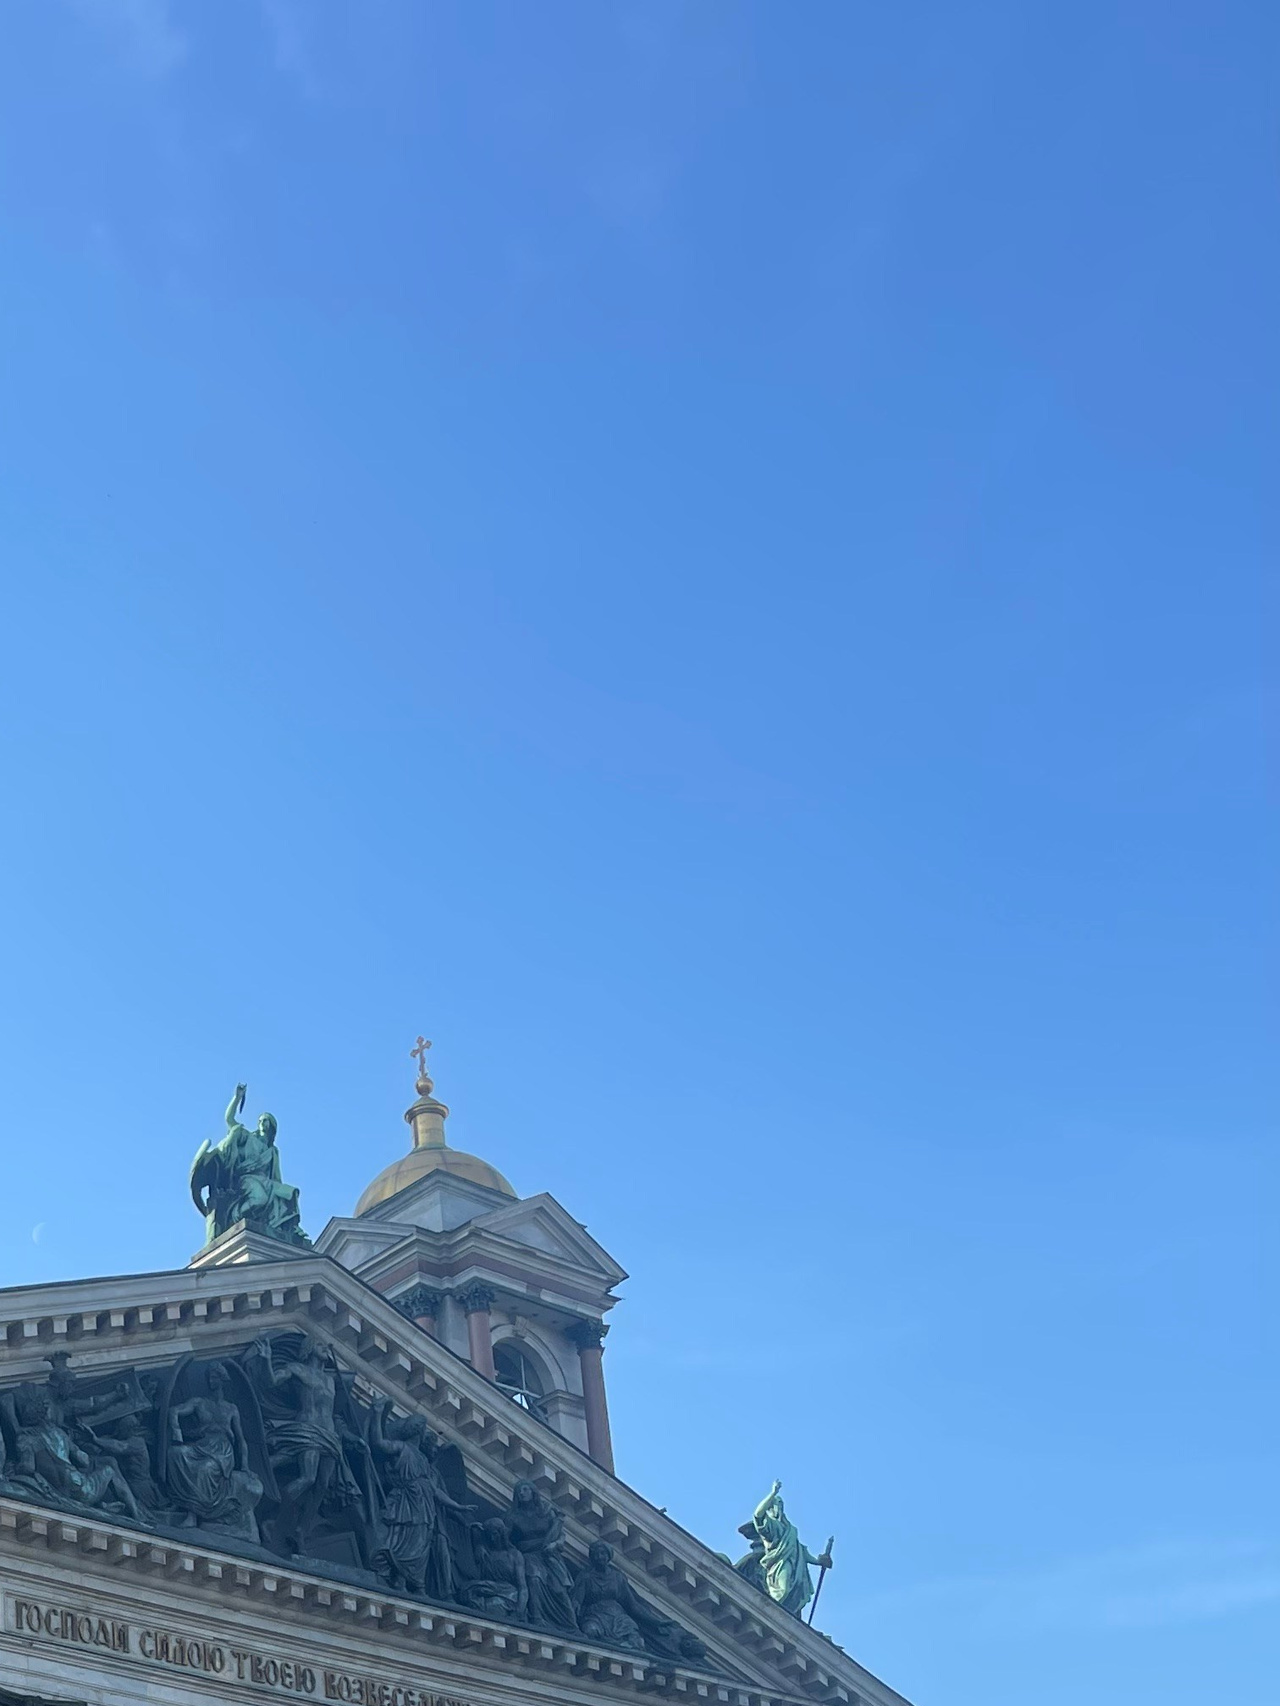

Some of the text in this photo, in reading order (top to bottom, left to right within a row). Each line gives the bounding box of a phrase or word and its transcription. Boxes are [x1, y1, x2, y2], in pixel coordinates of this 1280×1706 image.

[14, 1600, 130, 1653] ГОСПОДИ
[138, 1629, 225, 1673] СИЛОЮ
[230, 1649, 317, 1693] ТВОЕЮ
